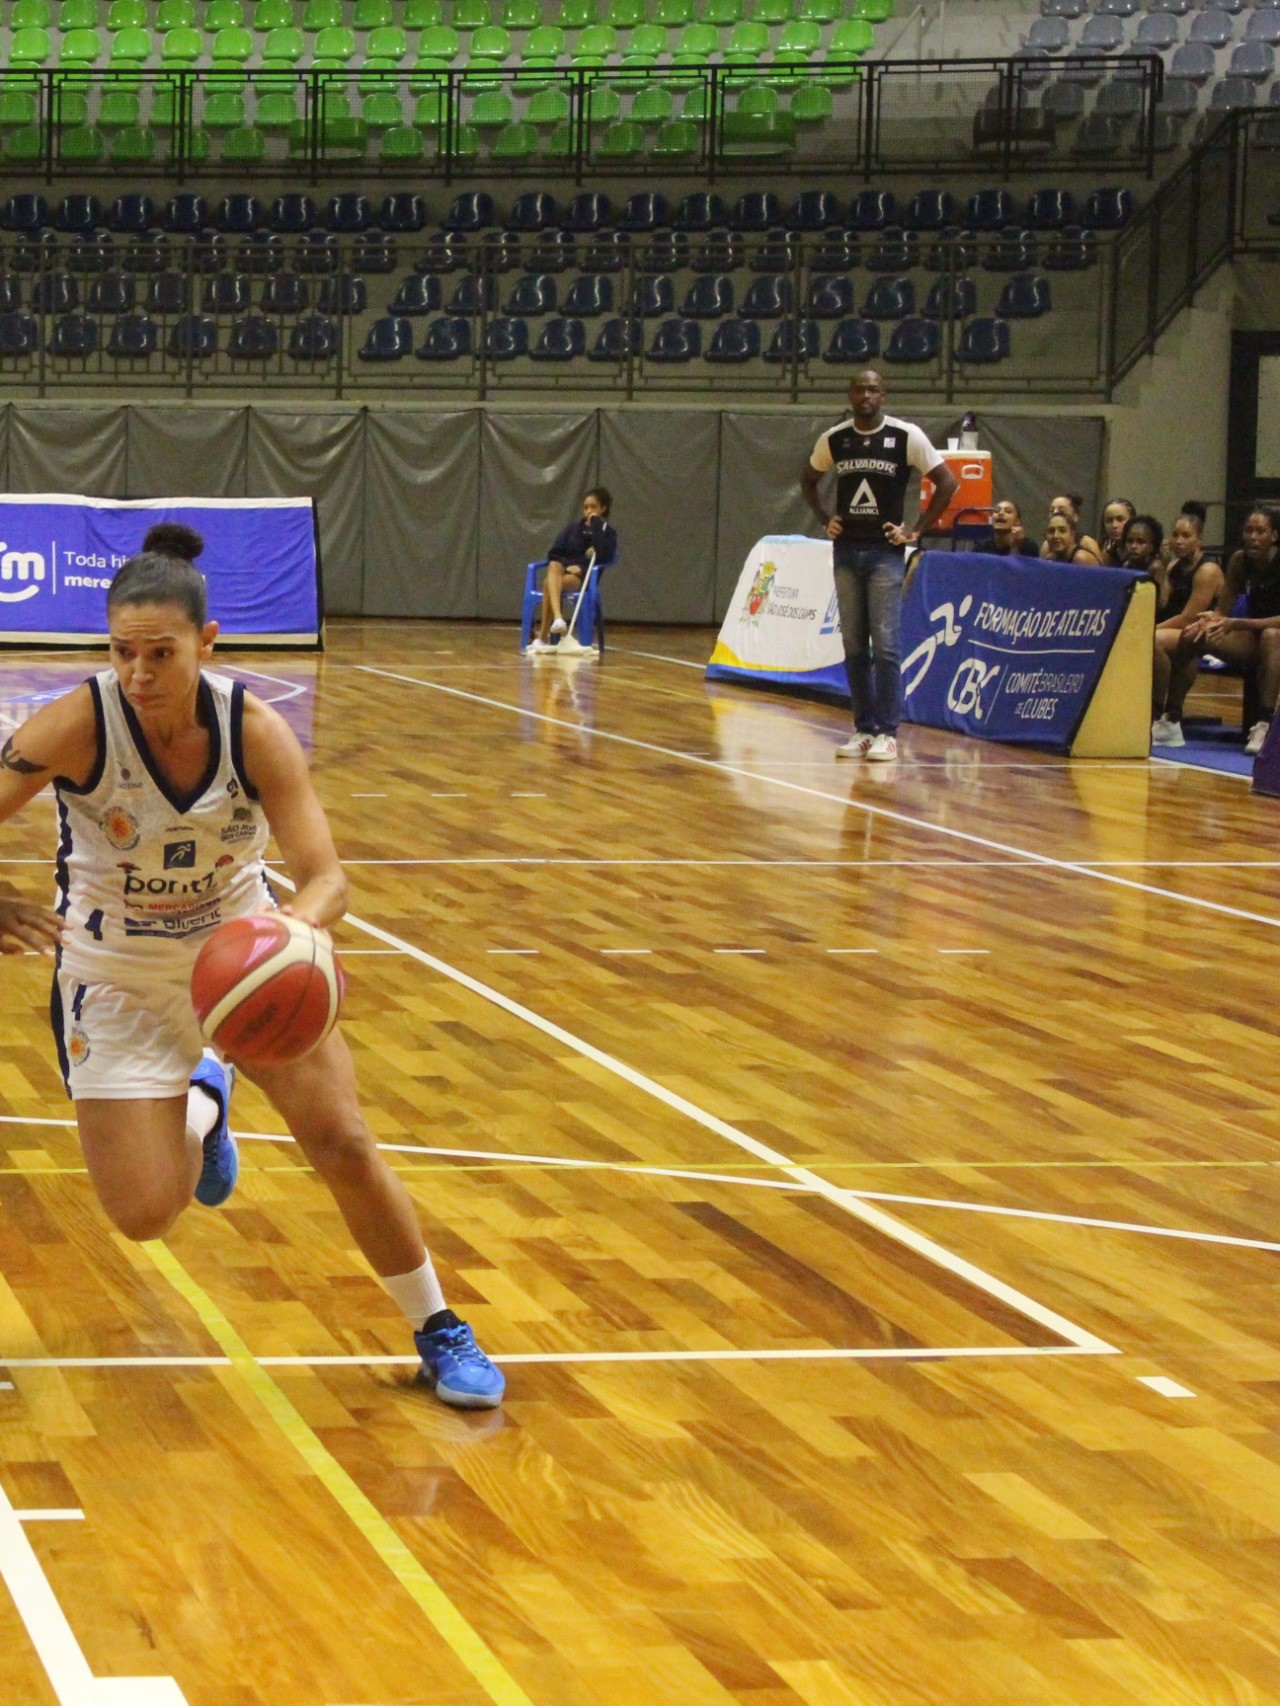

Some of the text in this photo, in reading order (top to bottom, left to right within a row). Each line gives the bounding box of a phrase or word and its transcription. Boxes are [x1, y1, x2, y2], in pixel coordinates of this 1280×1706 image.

[837, 459, 898, 476] SALVADOR
[63, 551, 106, 568] Toda
[973, 602, 1111, 645] FORMAÇÃO DE ATLETAS
[1005, 668, 1044, 694] COMITÊ
[1020, 698, 1059, 720] CLUBES
